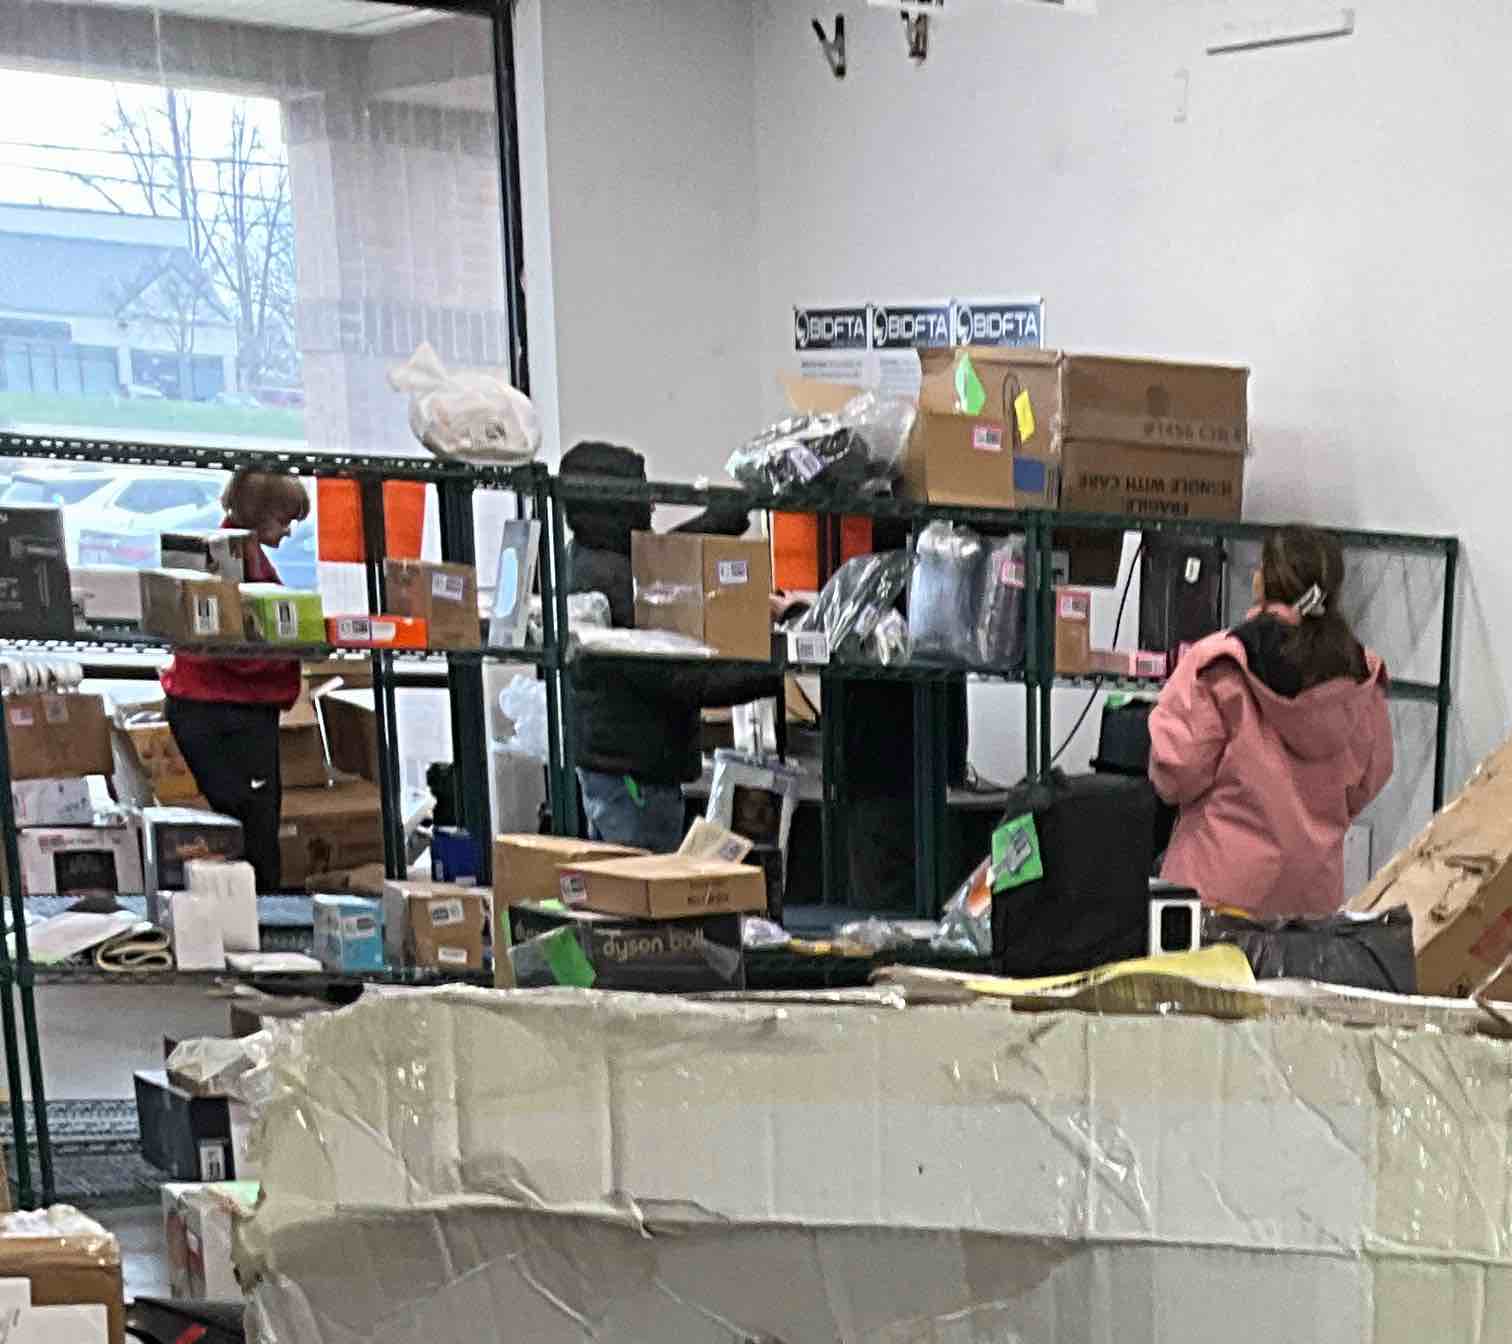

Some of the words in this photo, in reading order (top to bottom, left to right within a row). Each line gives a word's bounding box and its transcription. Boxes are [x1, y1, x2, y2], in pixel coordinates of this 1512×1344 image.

[809, 315, 864, 339] BIDFTA
[889, 313, 948, 338] BIDFTA
[974, 311, 1038, 337] BIDFTA
[602, 930, 665, 961] dyson
